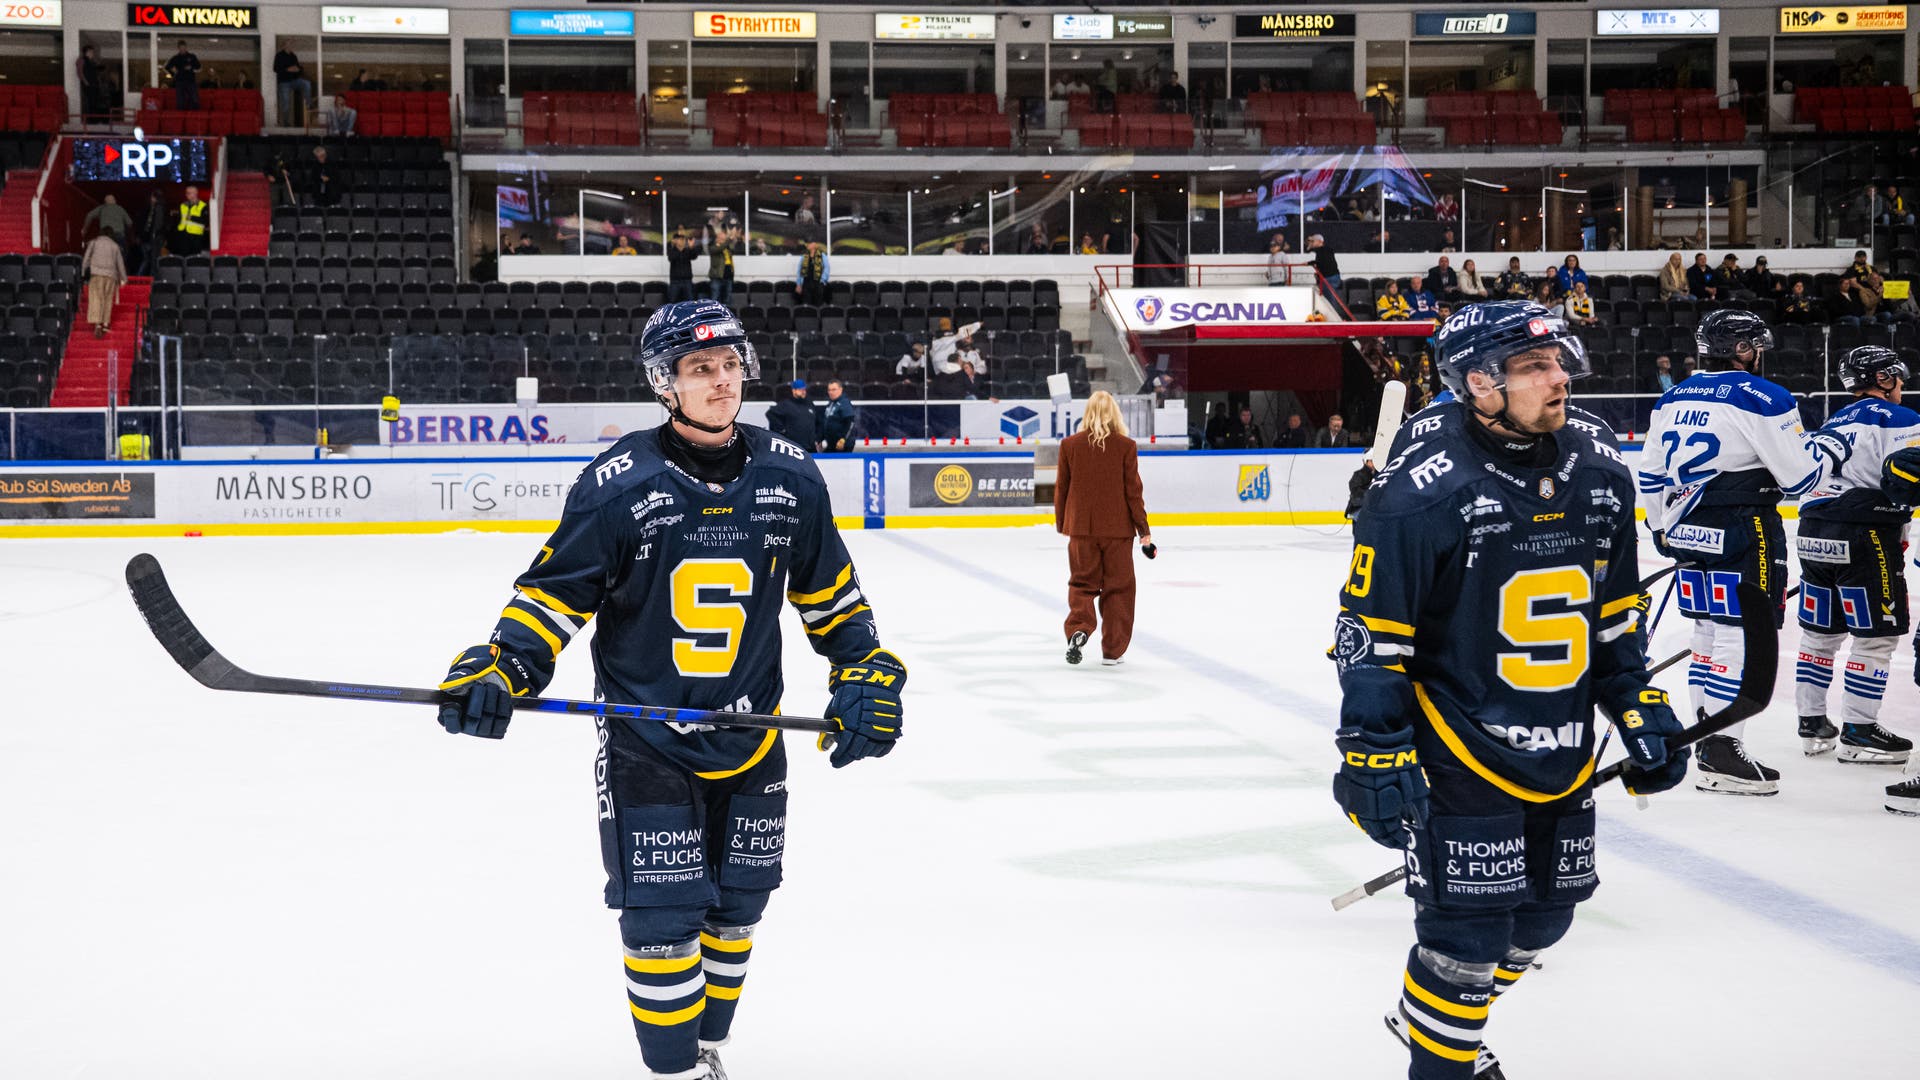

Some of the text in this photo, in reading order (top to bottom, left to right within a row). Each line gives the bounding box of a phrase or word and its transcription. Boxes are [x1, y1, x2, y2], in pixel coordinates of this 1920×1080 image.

[6, 5, 44, 18] ZOO
[135, 6, 250, 28] ICA NYKVARN
[326, 15, 356, 24] BST
[710, 14, 801, 35] STYRHYTTEN
[1261, 14, 1334, 29] MÅNSBRO
[122, 143, 173, 178] RP
[1169, 302, 1286, 322] SCANIA
[1449, 346, 1475, 363] CCM
[1674, 410, 1710, 427] LANG
[390, 415, 549, 443] BERRAS
[0, 480, 132, 494] Rub Sol Sweden AB
[216, 471, 372, 500] MÅNSBRO
[941, 474, 965, 482] GOLD
[977, 479, 996, 490] BE
[1513, 478, 1527, 488] AB
[755, 487, 770, 496] STÅL
[869, 461, 880, 514] CCM
[243, 507, 343, 518] FASTIGHETER
[702, 507, 734, 515] CCM
[1532, 512, 1566, 522] CCM
[683, 531, 750, 543] SILJENDAHLS
[1512, 536, 1586, 553] SILJENDAHLS
[1753, 516, 1767, 592] JORDKULLEN
[1868, 530, 1890, 600] JORDKULLEN
[670, 558, 754, 678] S
[1496, 564, 1592, 692] S
[511, 657, 529, 680] CCM
[1873, 669, 1890, 679] He
[1622, 710, 1644, 729] S
[1637, 738, 1653, 760] CCM
[1346, 749, 1418, 769] CCM
[632, 828, 703, 847] THOMAN
[731, 832, 785, 851] & FUCHS
[1445, 836, 1526, 858] THOMAN
[632, 847, 703, 867] & FUCHS
[1557, 857, 1571, 872] &
[1446, 856, 1526, 877] & FUCHS
[633, 870, 704, 883] ENTREPRENAD AB
[1447, 880, 1527, 895] ENTREPRENAD AB
[641, 944, 673, 953] CCM
